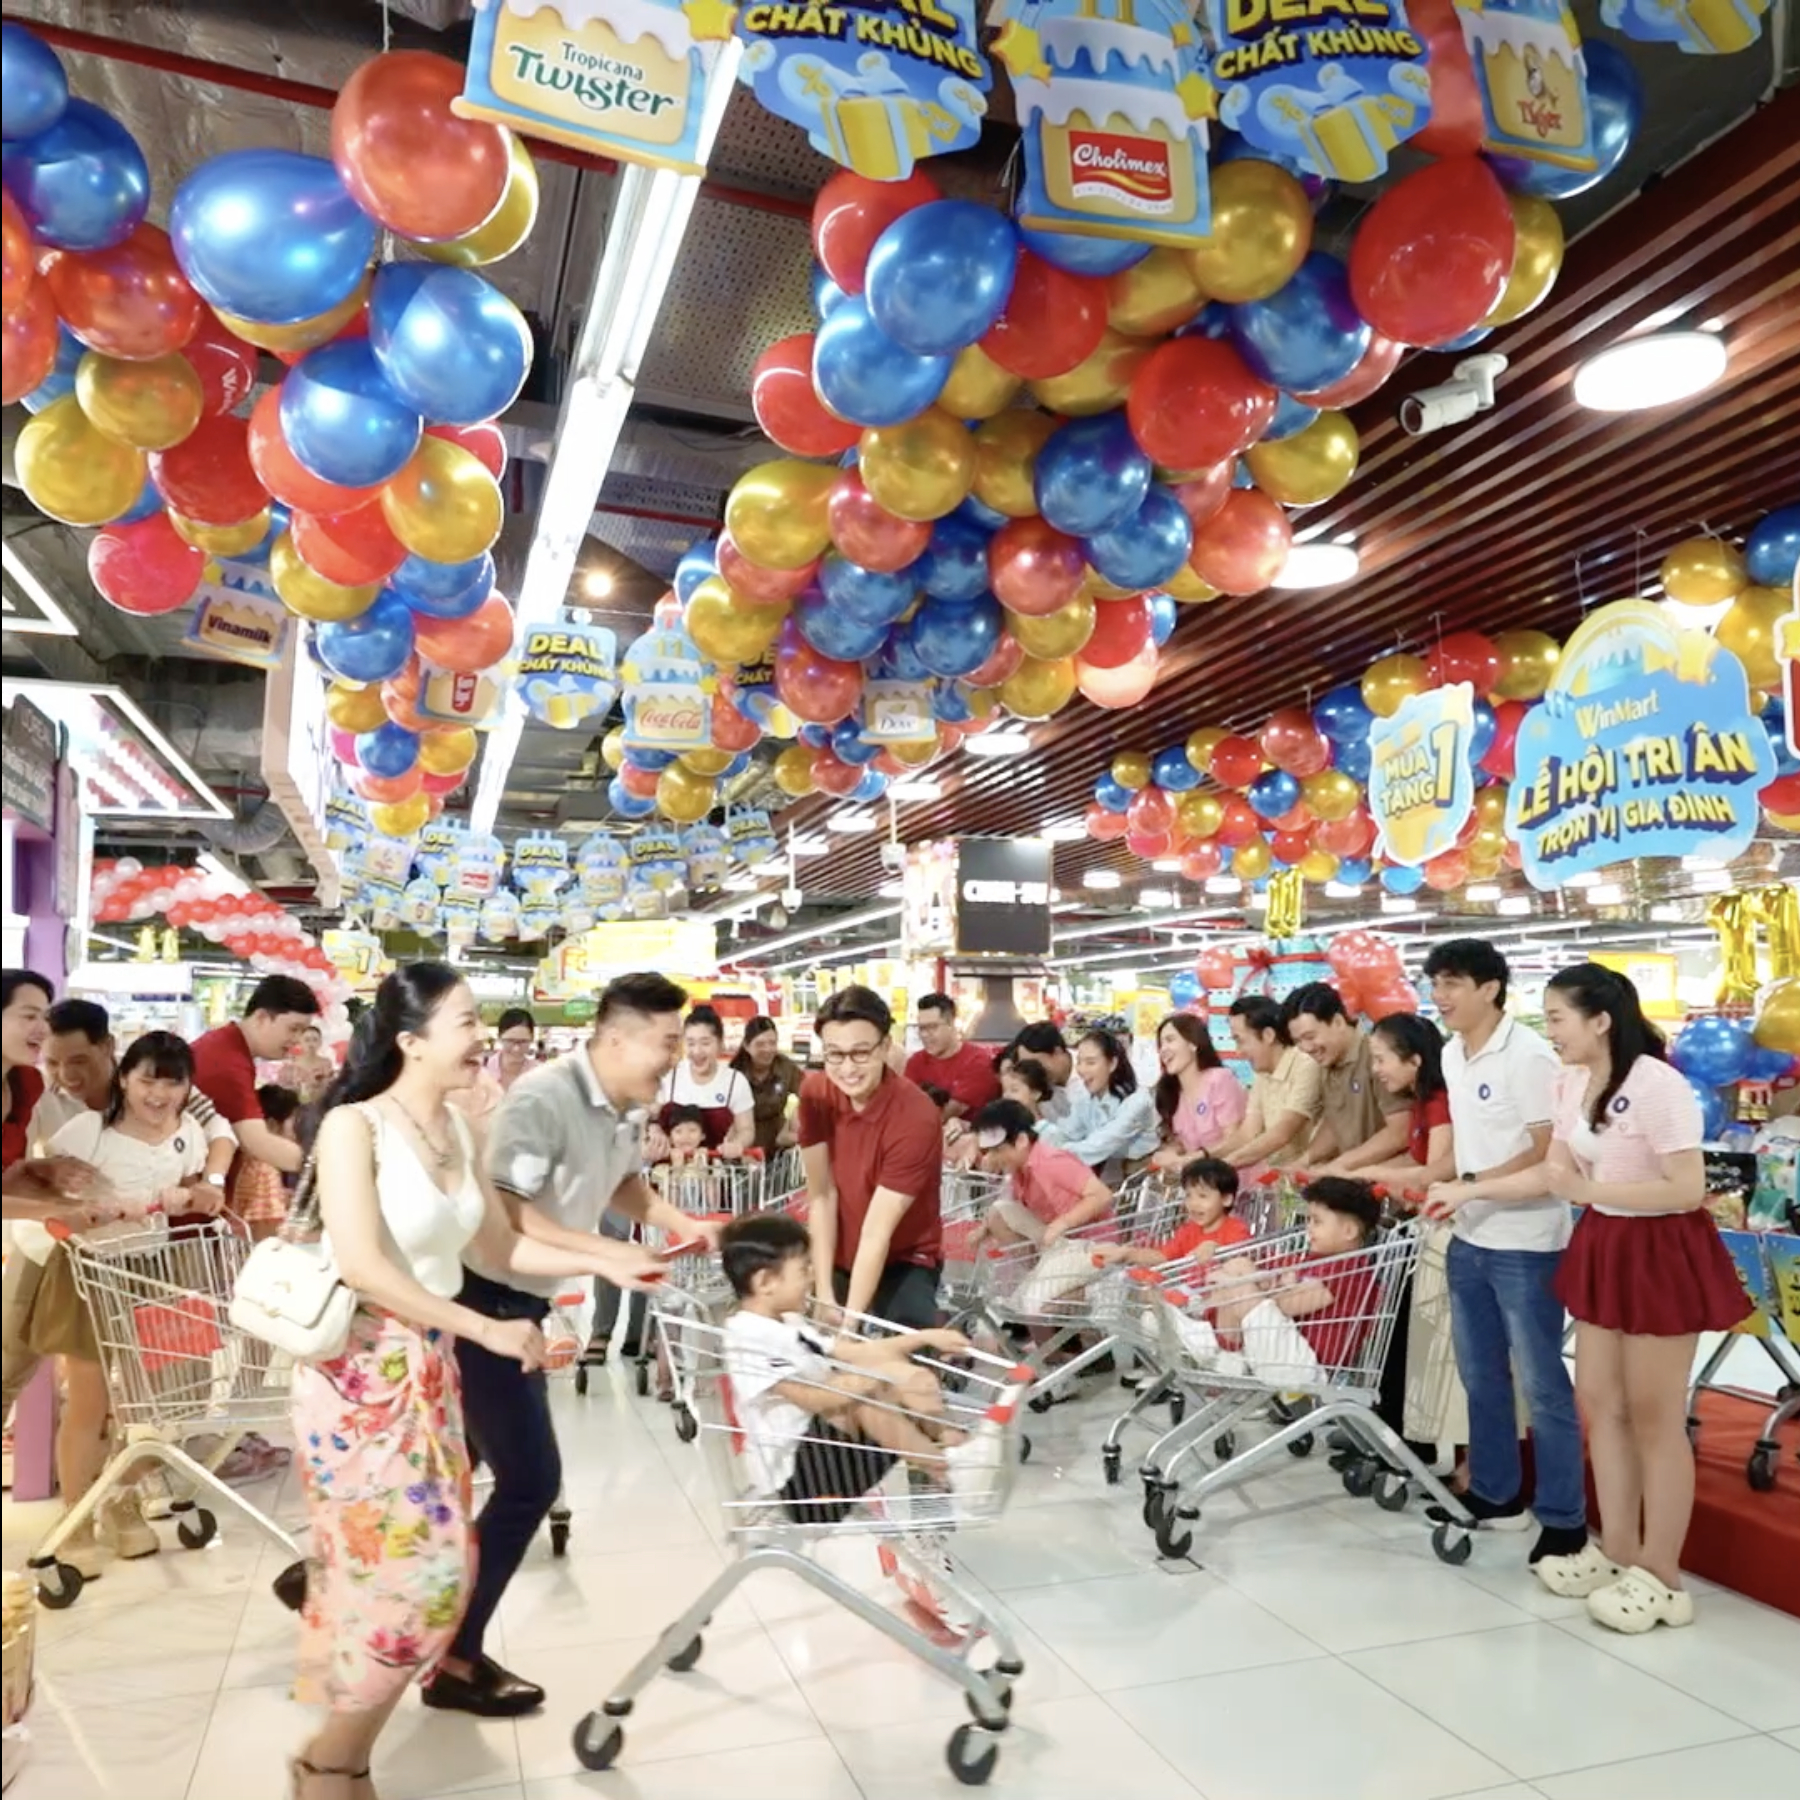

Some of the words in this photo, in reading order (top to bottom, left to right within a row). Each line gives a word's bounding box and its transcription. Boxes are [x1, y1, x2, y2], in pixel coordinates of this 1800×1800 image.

[561, 41, 644, 81] Tropicana
[743, 0, 847, 36] CHẤT
[856, 14, 983, 79] KHỦNG
[1214, 26, 1299, 78] CHẤT
[1306, 19, 1422, 55] KHỦNG
[509, 44, 675, 117] Twister
[1072, 143, 1168, 177] Cholimex
[208, 613, 271, 644] Vinamilk
[528, 633, 605, 661] DEAL
[1575, 689, 1660, 740] WinMart
[1384, 745, 1431, 787] MUA
[1431, 721, 1458, 807] 1
[1516, 756, 1555, 826] LỄ
[1558, 743, 1618, 806] HỘI
[1623, 735, 1683, 784] TRI
[1688, 721, 1758, 778] ÂN
[1537, 813, 1592, 859] TRỌN
[1622, 798, 1666, 829] GIA
[1667, 787, 1737, 825] ĐÌNH
